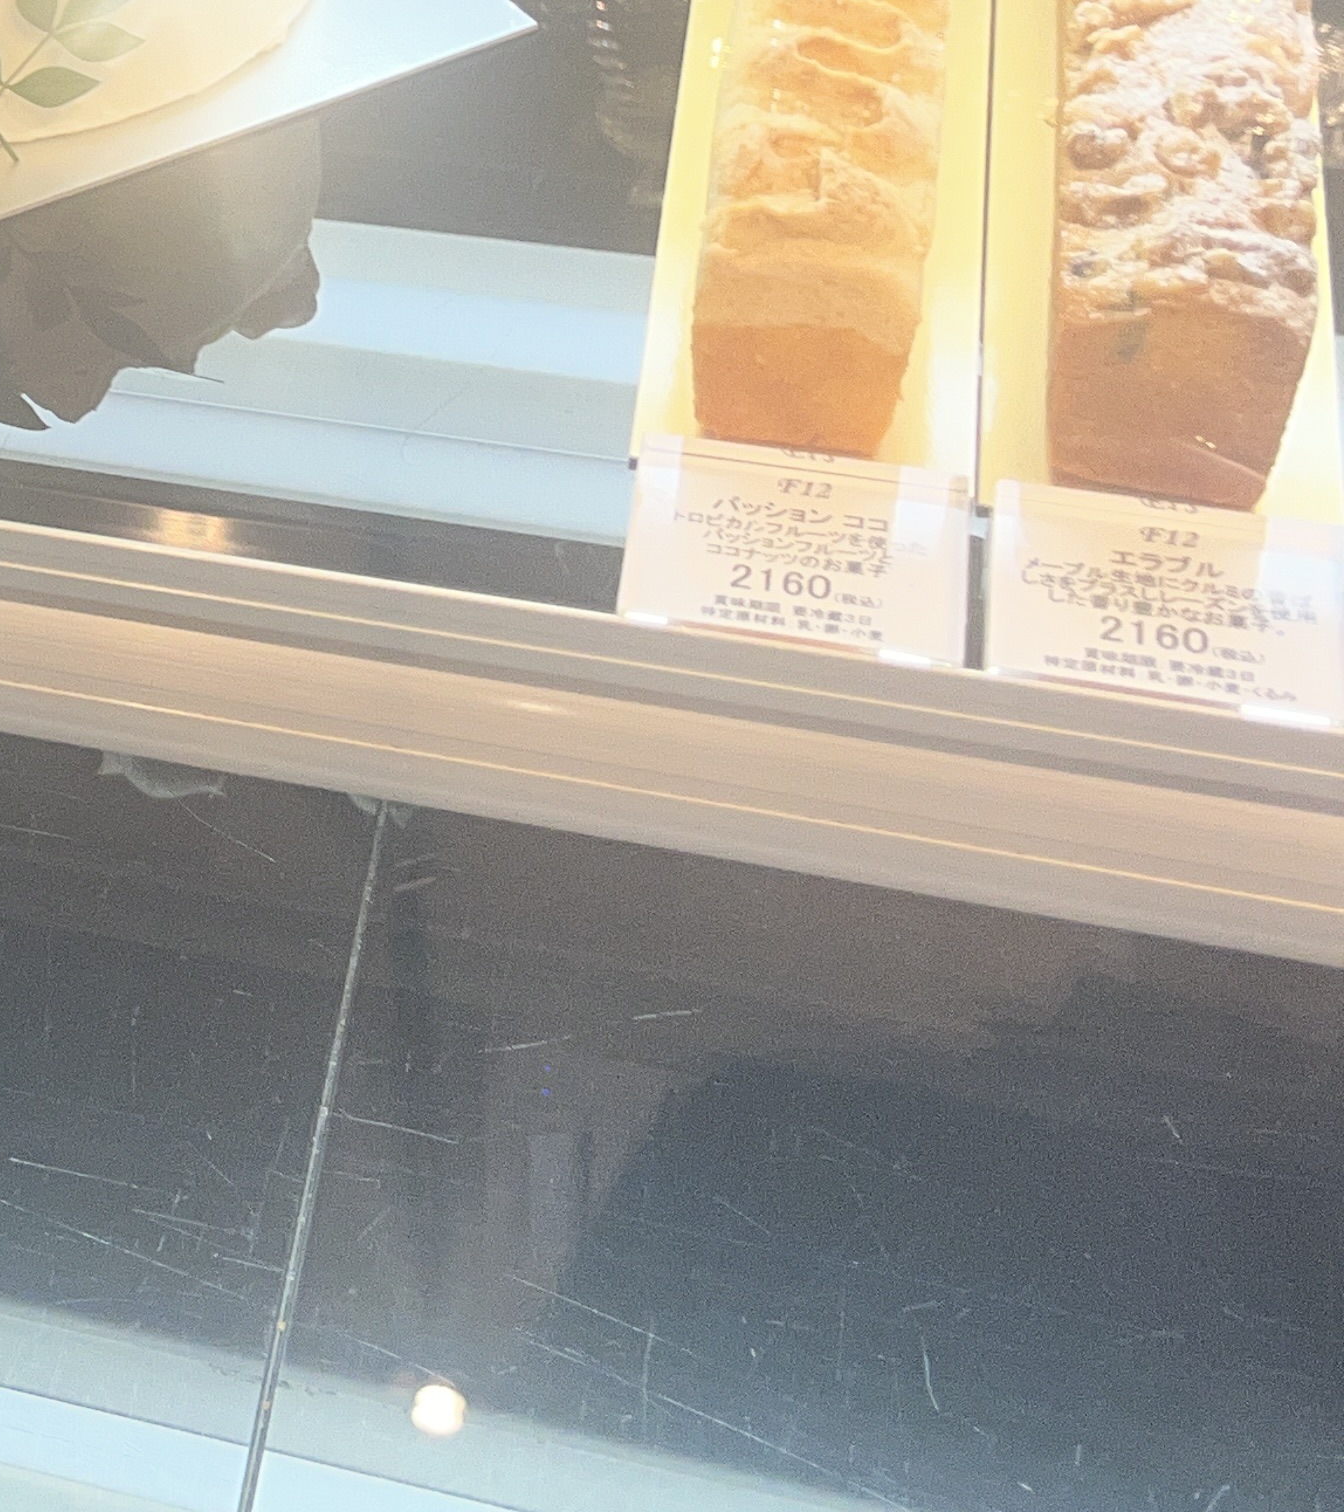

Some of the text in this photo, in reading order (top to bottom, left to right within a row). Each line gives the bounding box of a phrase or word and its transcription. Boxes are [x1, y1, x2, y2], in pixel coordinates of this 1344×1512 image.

[712, 495, 889, 532] パッション ココ
[703, 528, 895, 566] パッションフルーツと
[706, 542, 889, 578] ココナッツのお菓子
[1109, 550, 1226, 578] エラブル
[730, 563, 832, 600] 2160
[1100, 615, 1210, 654] 2160
